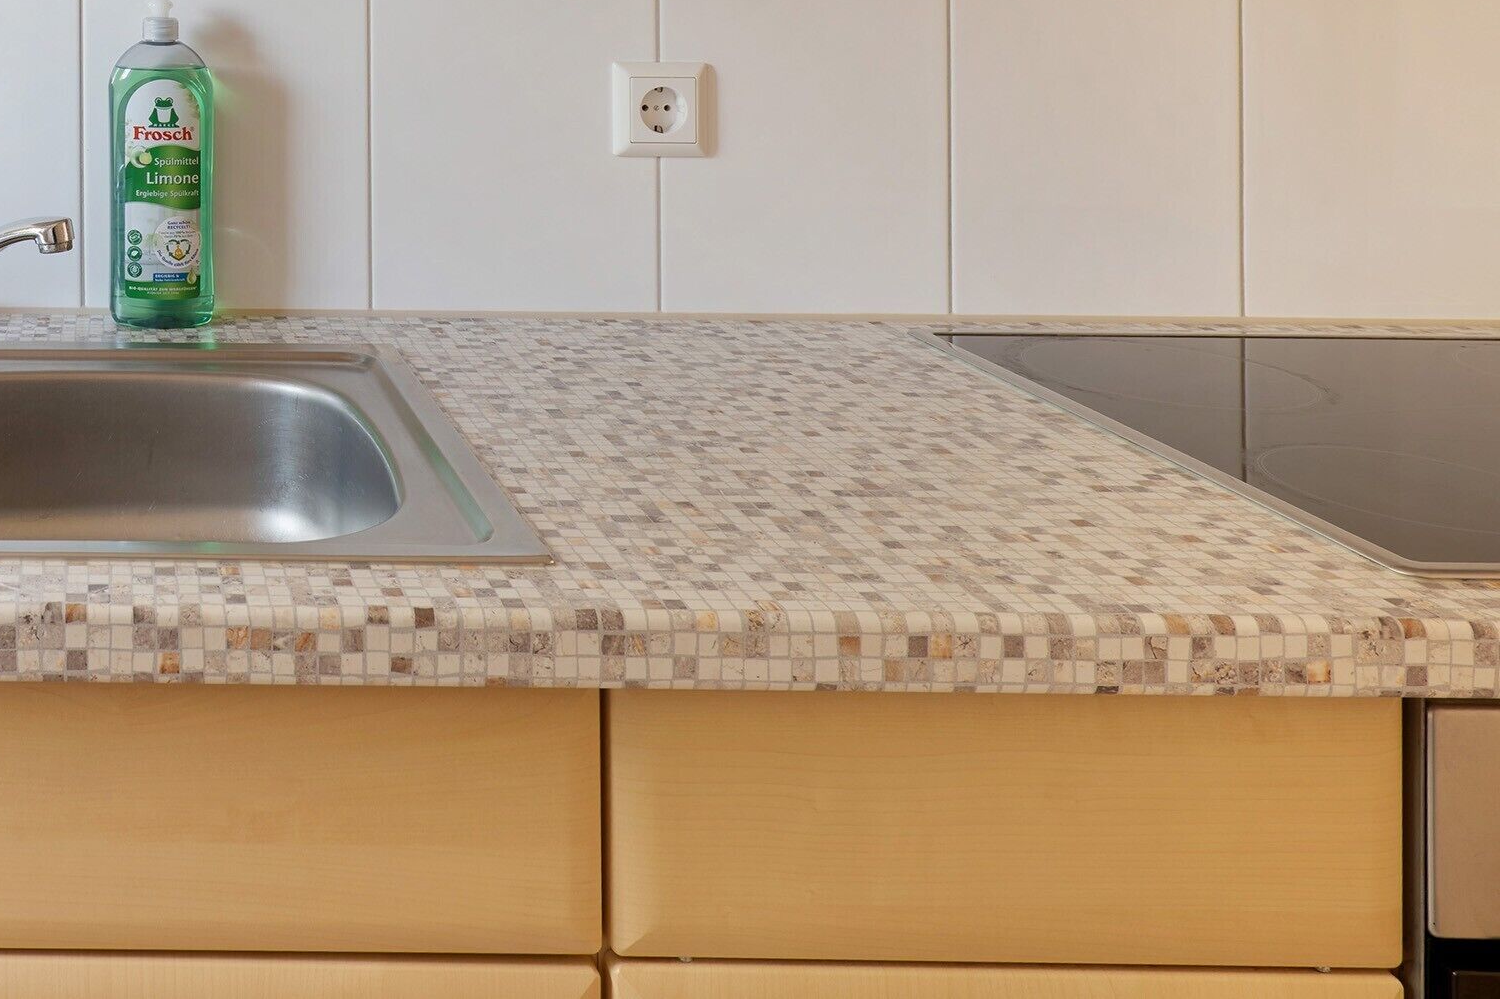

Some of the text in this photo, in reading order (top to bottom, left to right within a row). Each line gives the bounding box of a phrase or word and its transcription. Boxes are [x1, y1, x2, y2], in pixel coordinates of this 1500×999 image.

[133, 126, 193, 141] Frosch
[154, 157, 199, 167] Spülmittel
[146, 172, 199, 185] Limone
[135, 189, 199, 198] Ergiebige Spülkraft
